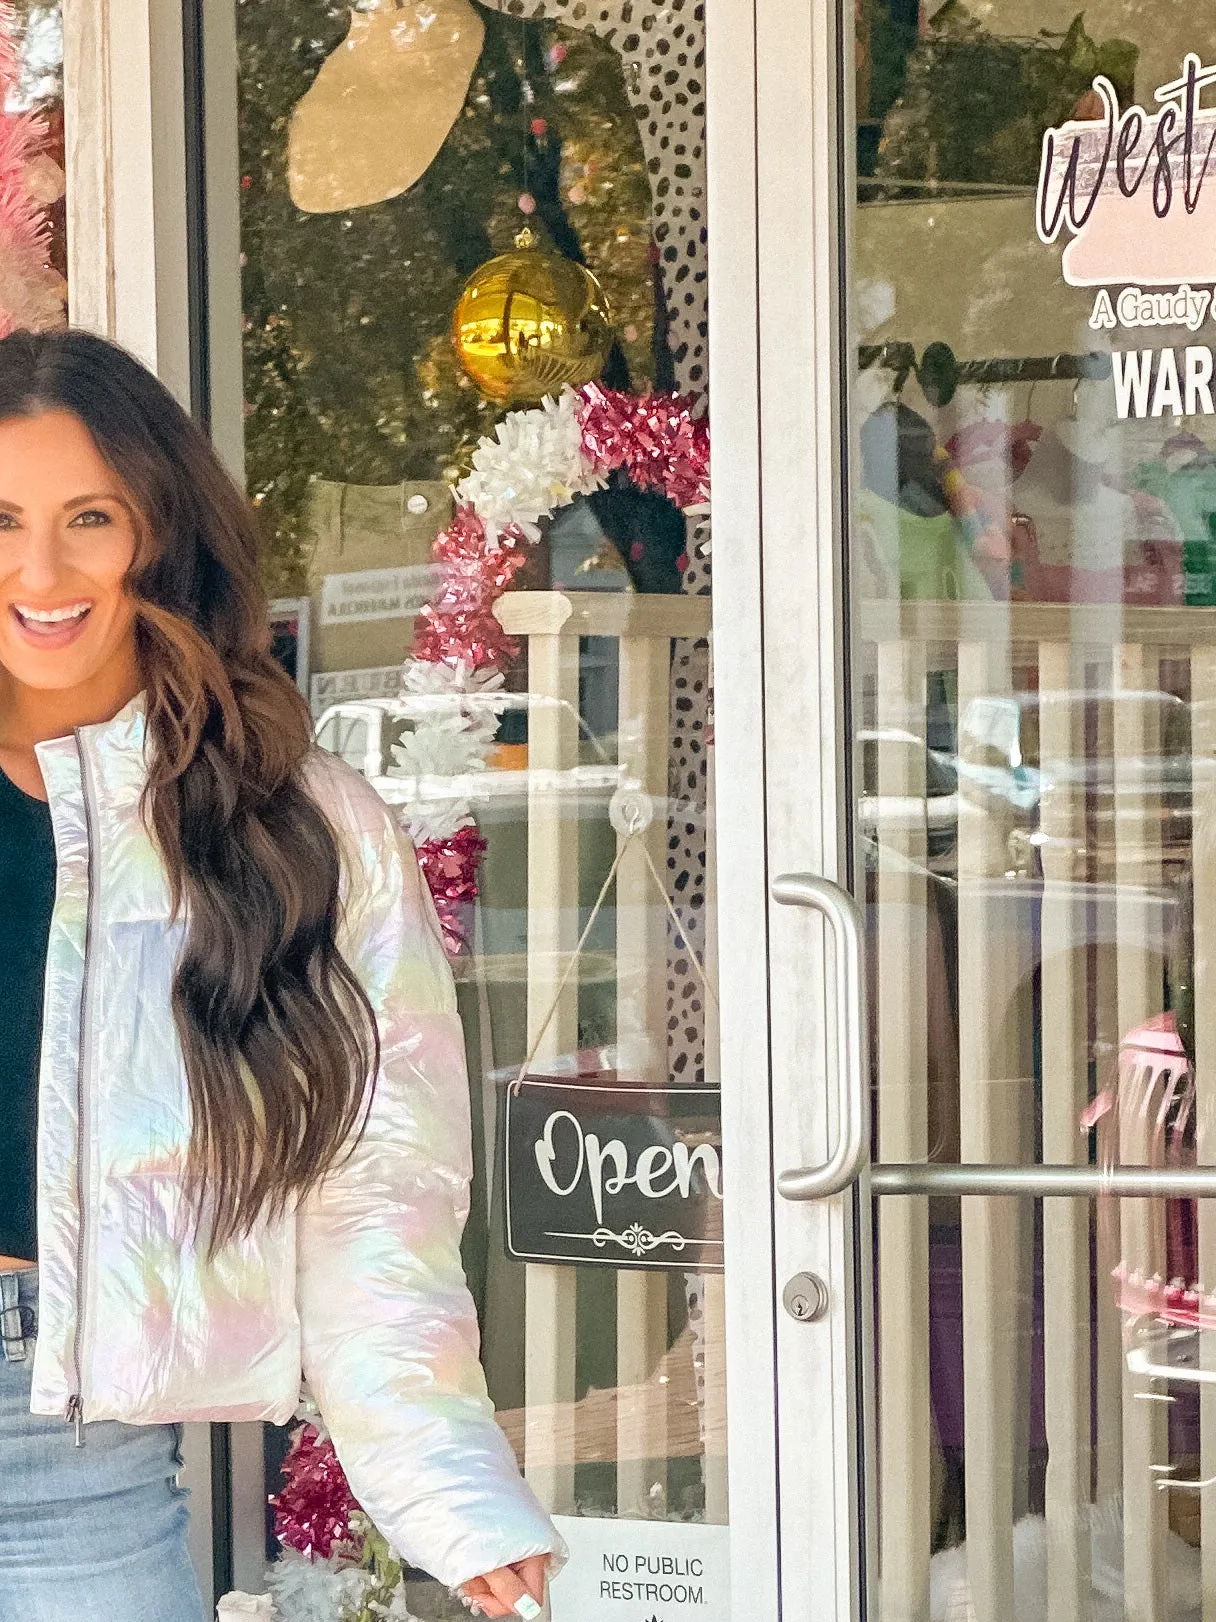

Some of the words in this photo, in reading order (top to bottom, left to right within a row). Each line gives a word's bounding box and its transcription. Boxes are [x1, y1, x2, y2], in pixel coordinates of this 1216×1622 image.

[1091, 288, 1115, 326] A
[1119, 287, 1208, 327] Gaudy
[1111, 345, 1215, 419] WAR
[534, 1110, 724, 1224] Open
[602, 1553, 629, 1573] NO
[635, 1555, 704, 1576] PUBLIC
[600, 1580, 708, 1604] RESTROOM.
